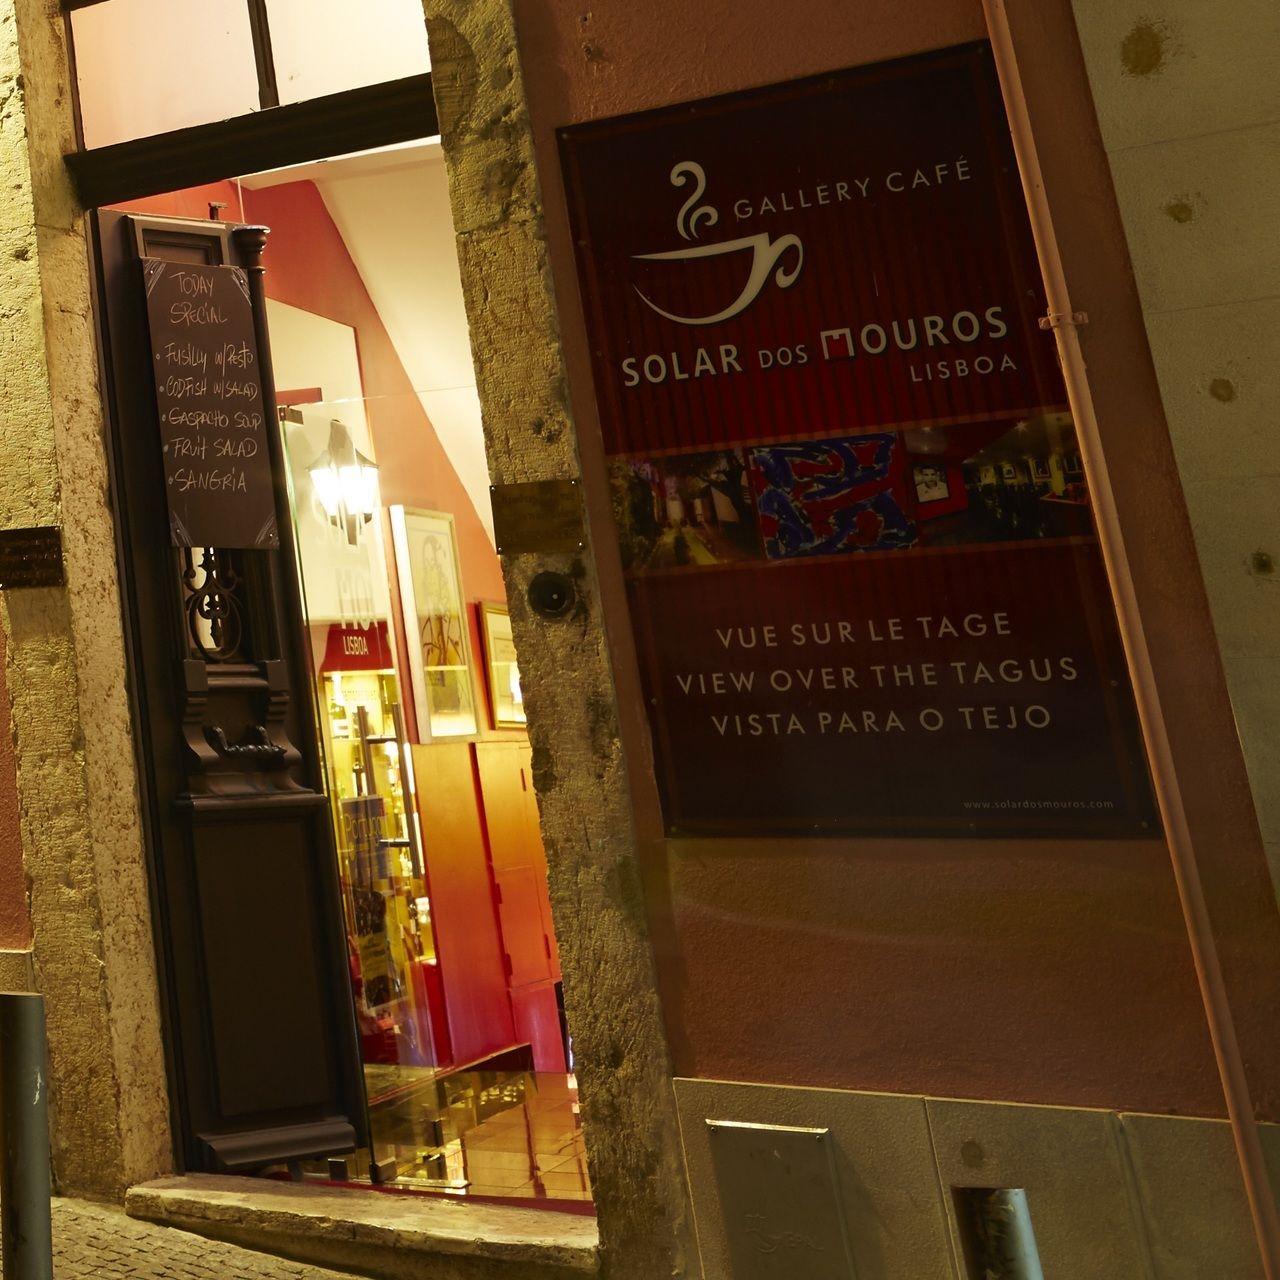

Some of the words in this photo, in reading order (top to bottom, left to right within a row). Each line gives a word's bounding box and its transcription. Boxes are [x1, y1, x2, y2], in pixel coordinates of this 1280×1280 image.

[733, 177, 871, 220] GALLERY
[886, 155, 973, 194] CAFÉ
[168, 271, 214, 297] TODAY
[622, 343, 744, 387] SOLAR
[758, 344, 809, 369] DOS
[910, 353, 1018, 383] LISBOA
[213, 437, 258, 458] SALAD
[342, 635, 369, 655] LISBOA
[715, 626, 779, 650] VUE
[790, 621, 856, 646] SUR
[868, 618, 903, 642] LE
[916, 612, 1011, 640] TAGE
[676, 671, 755, 697] VIEW
[770, 667, 859, 693] OVER
[870, 663, 938, 688] THE
[950, 656, 1078, 686] TAGUS
[711, 713, 806, 737] VISTA
[818, 708, 906, 734] PARA
[918, 707, 944, 732] O
[958, 704, 1052, 731] TEJO
[963, 799, 1115, 811] www.solardosmouros.com
